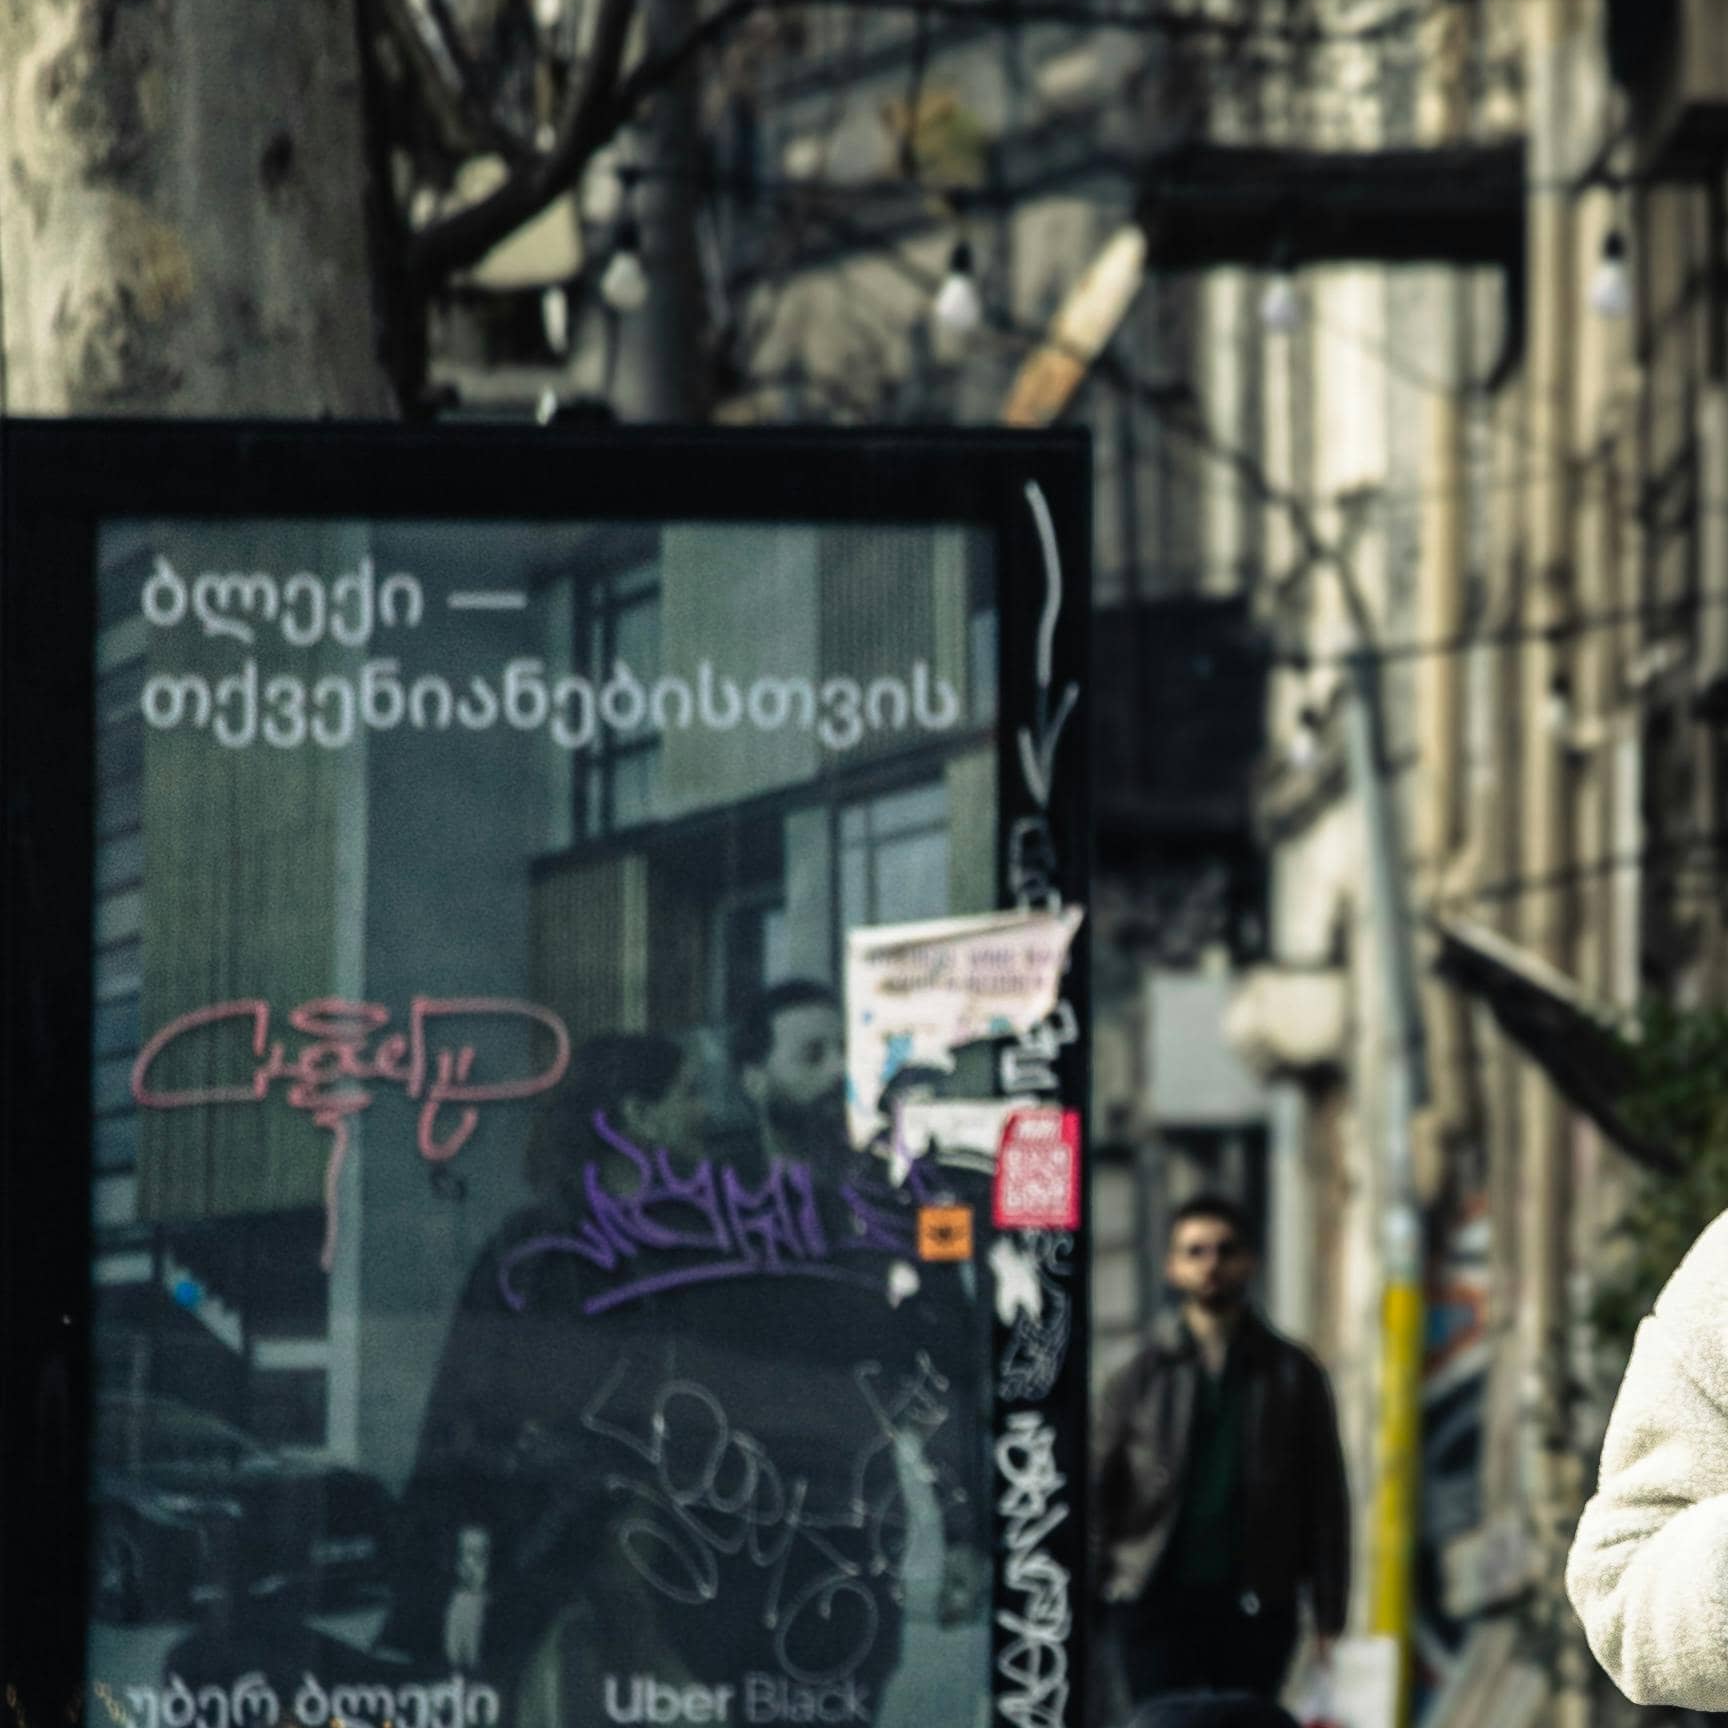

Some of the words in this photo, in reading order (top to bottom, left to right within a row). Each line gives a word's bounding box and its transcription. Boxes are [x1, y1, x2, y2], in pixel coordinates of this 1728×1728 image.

[141, 555, 425, 647] ბლექი
[140, 657, 960, 750] თქვენიანებისთვის
[604, 1674, 735, 1724] Uber
[743, 1674, 871, 1725] Black
